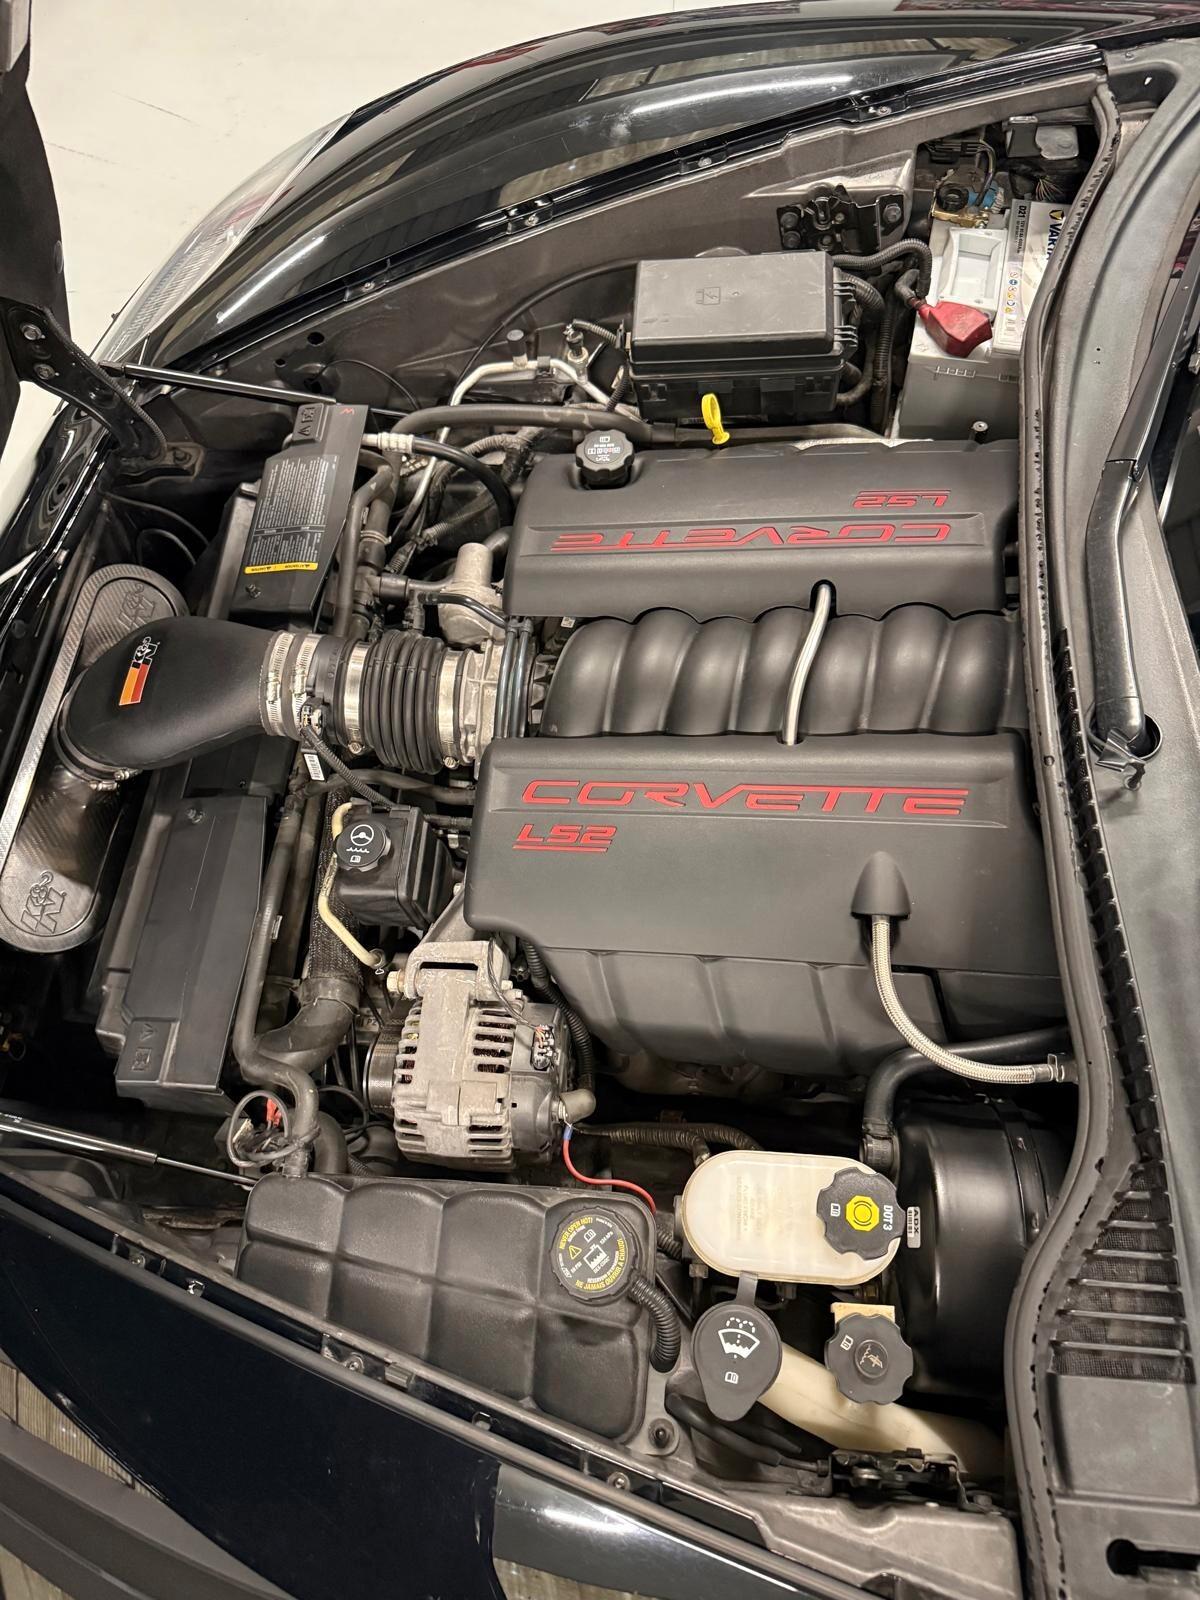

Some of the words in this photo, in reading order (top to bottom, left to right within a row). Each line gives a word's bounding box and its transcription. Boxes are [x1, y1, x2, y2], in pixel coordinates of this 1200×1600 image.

[1018, 205, 1027, 218] D21
[853, 490, 951, 509] LS2
[551, 522, 951, 552] CORVETTE
[521, 779, 969, 816] CORVETTE
[515, 823, 617, 853] LS2
[21, 870, 67, 933] K&N
[883, 1204, 893, 1222] DOT
[559, 1230, 569, 1250] NEVER
[568, 1220, 582, 1234] OPEN
[581, 1216, 593, 1225] HOT!
[883, 1223, 893, 1231] 3
[584, 1281, 606, 1290] JAMAIS
